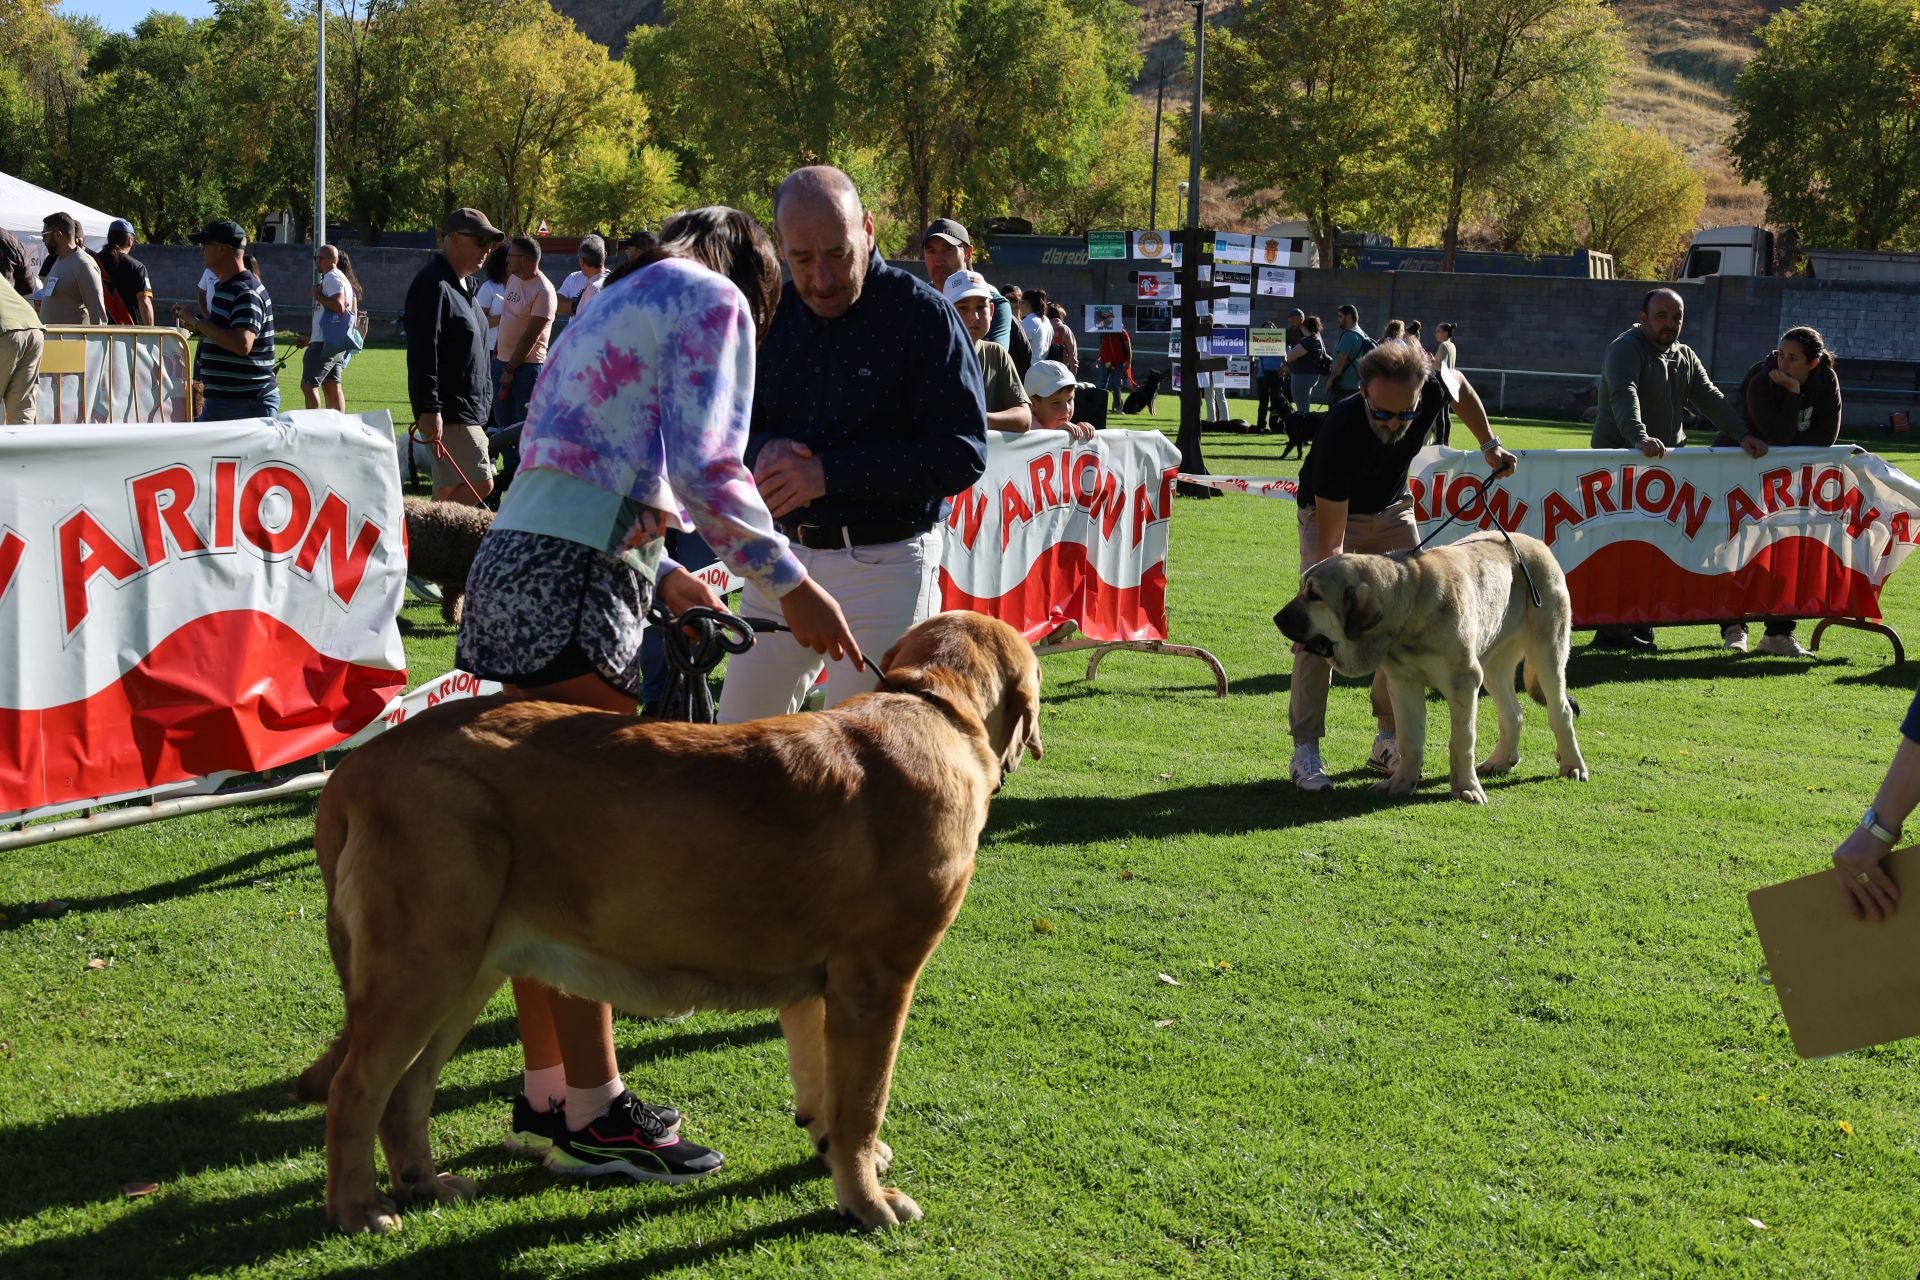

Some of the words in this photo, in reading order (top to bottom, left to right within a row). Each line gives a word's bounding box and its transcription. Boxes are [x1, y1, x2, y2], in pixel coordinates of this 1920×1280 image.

[1000, 449, 1127, 555] ARION
[1542, 465, 1713, 546] ARION
[1726, 464, 1881, 544] ARION
[55, 458, 384, 643] ARION
[427, 672, 481, 709] ARION
